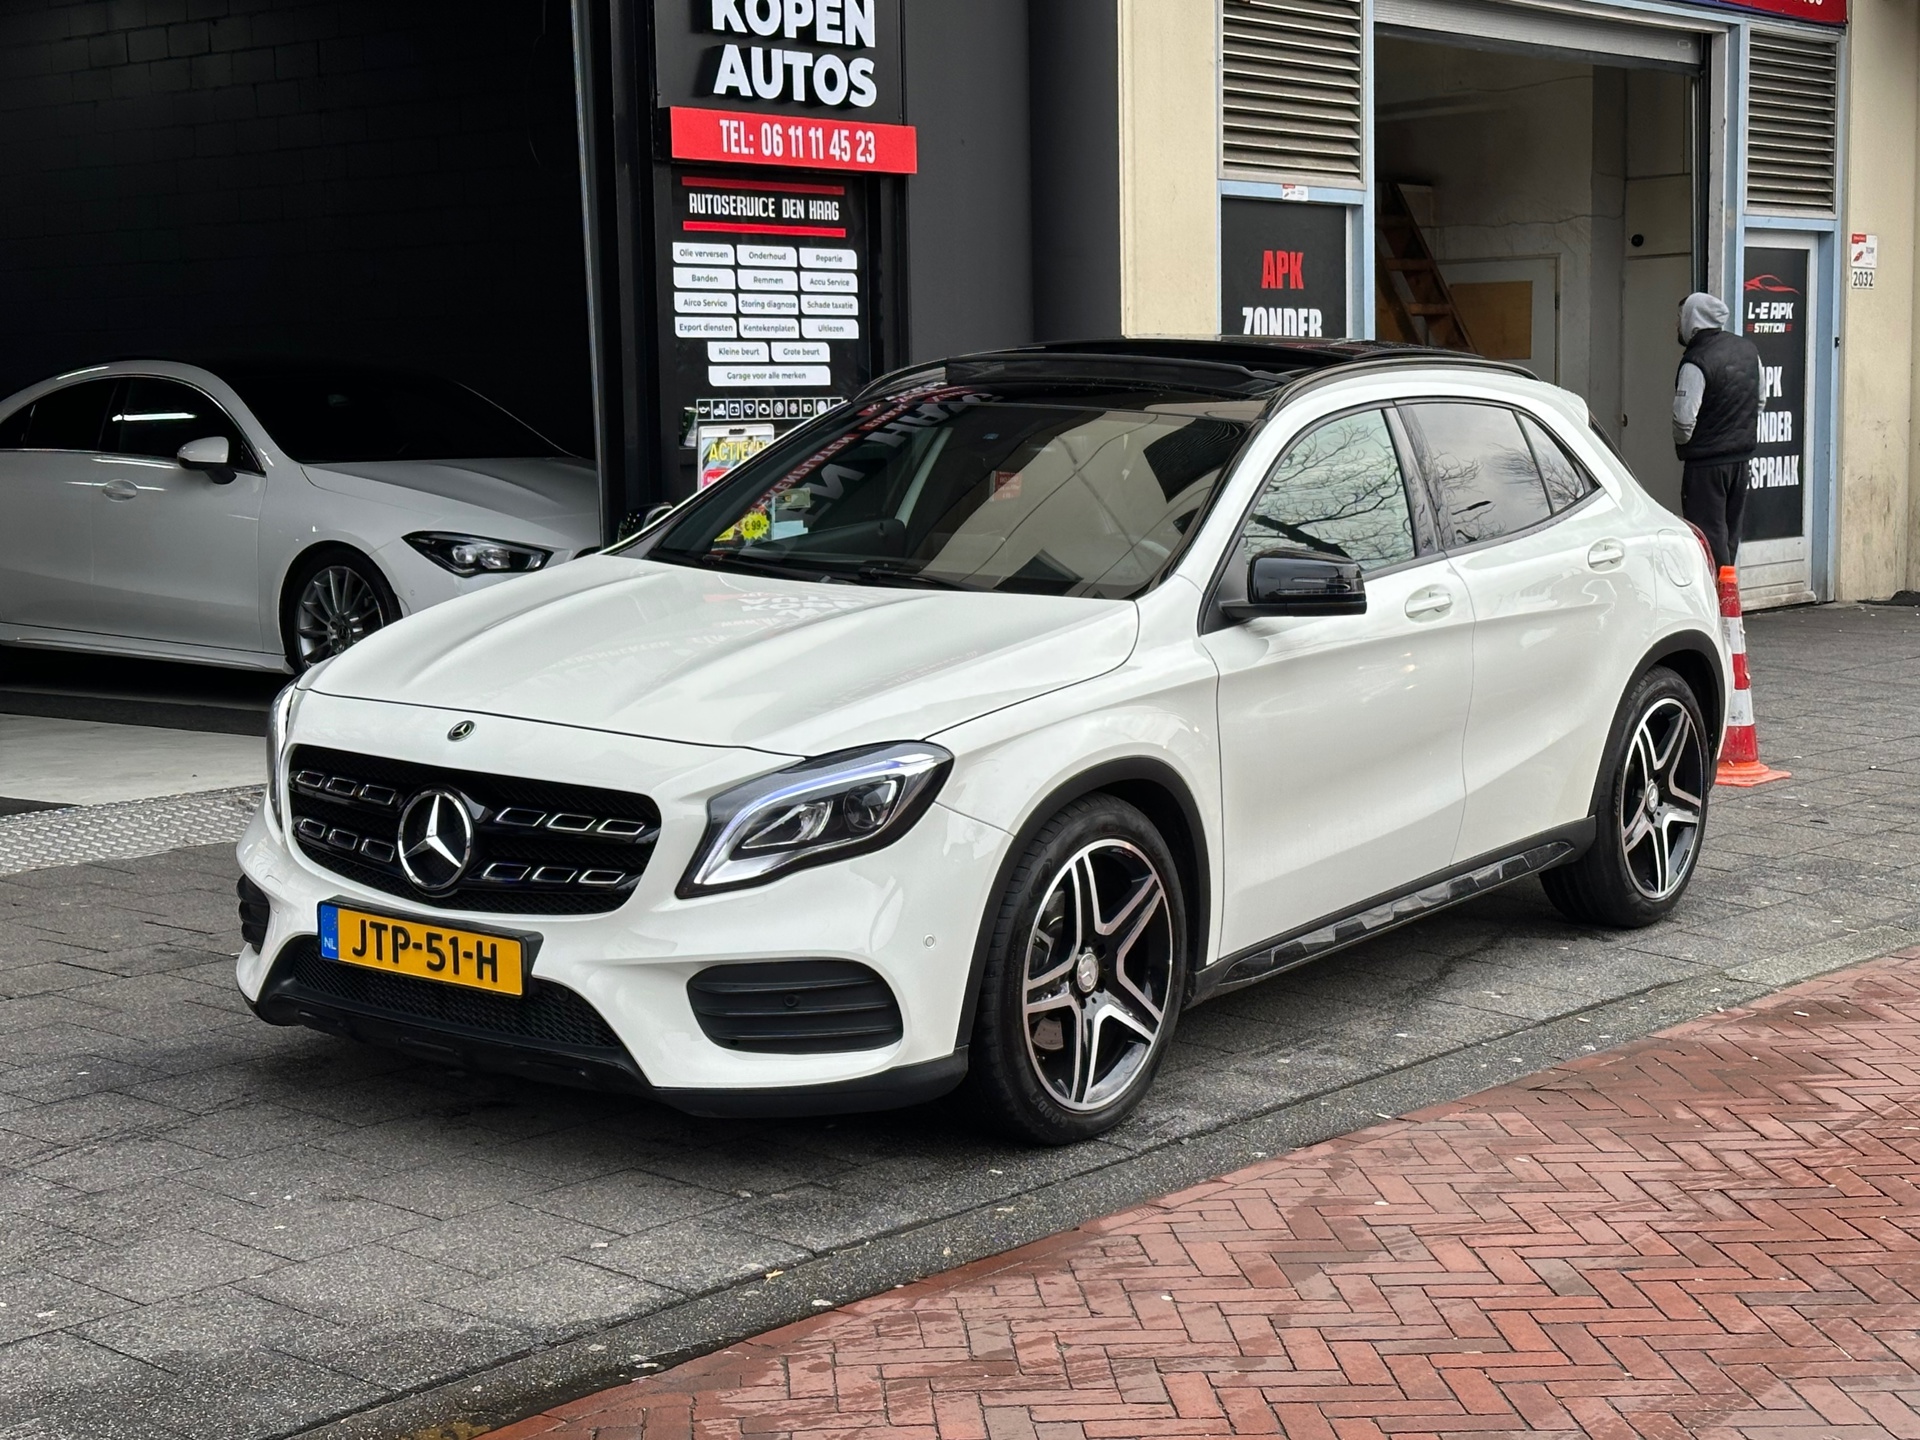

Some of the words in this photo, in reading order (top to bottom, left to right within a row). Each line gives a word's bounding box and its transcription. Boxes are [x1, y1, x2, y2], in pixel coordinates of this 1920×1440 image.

[712, 0, 876, 48] KOPEN
[713, 44, 877, 108] AUTOS
[719, 119, 755, 155] TEL:
[761, 122, 783, 157] 06
[788, 125, 804, 158] 11
[809, 127, 824, 160] 11
[829, 129, 850, 162] 45
[856, 130, 876, 164] 23
[782, 198, 805, 219] DEN
[809, 200, 840, 221] HAAG
[680, 248, 694, 257] Olie
[695, 250, 729, 258] verversen
[748, 251, 787, 260] Onderhoud
[1261, 250, 1304, 290] APK
[691, 274, 719, 283] Banden
[753, 276, 784, 285] Remmen
[809, 278, 826, 286] Accu
[827, 278, 850, 287] Service
[1853, 271, 1874, 287] 2032
[683, 298, 702, 307] Airco
[703, 299, 728, 308] Service
[741, 299, 765, 310] Storing
[766, 300, 797, 310] diagnose
[807, 301, 831, 309] Schade
[832, 302, 854, 310] taxatie
[1747, 301, 1770, 320] L-E
[1770, 302, 1794, 320] APK
[679, 323, 702, 332] Export
[703, 323, 734, 332] diensten
[1242, 307, 1323, 338] ZONDER
[1753, 322, 1786, 334] STATION
[743, 324, 796, 334] Kentekenplaten
[818, 324, 845, 333] Uitlezen
[719, 347, 740, 356] Kleine
[741, 347, 760, 356] beurt
[783, 348, 801, 356] Grote
[802, 347, 821, 356] beurt
[726, 371, 752, 382] Garage
[768, 371, 780, 380] alle
[781, 371, 807, 380] merken
[1761, 366, 1783, 398] PK
[1757, 411, 1792, 443] NDER
[1747, 455, 1799, 489] SPRAAK
[324, 935, 337, 951] NL
[352, 918, 498, 983] JTP-51-H
